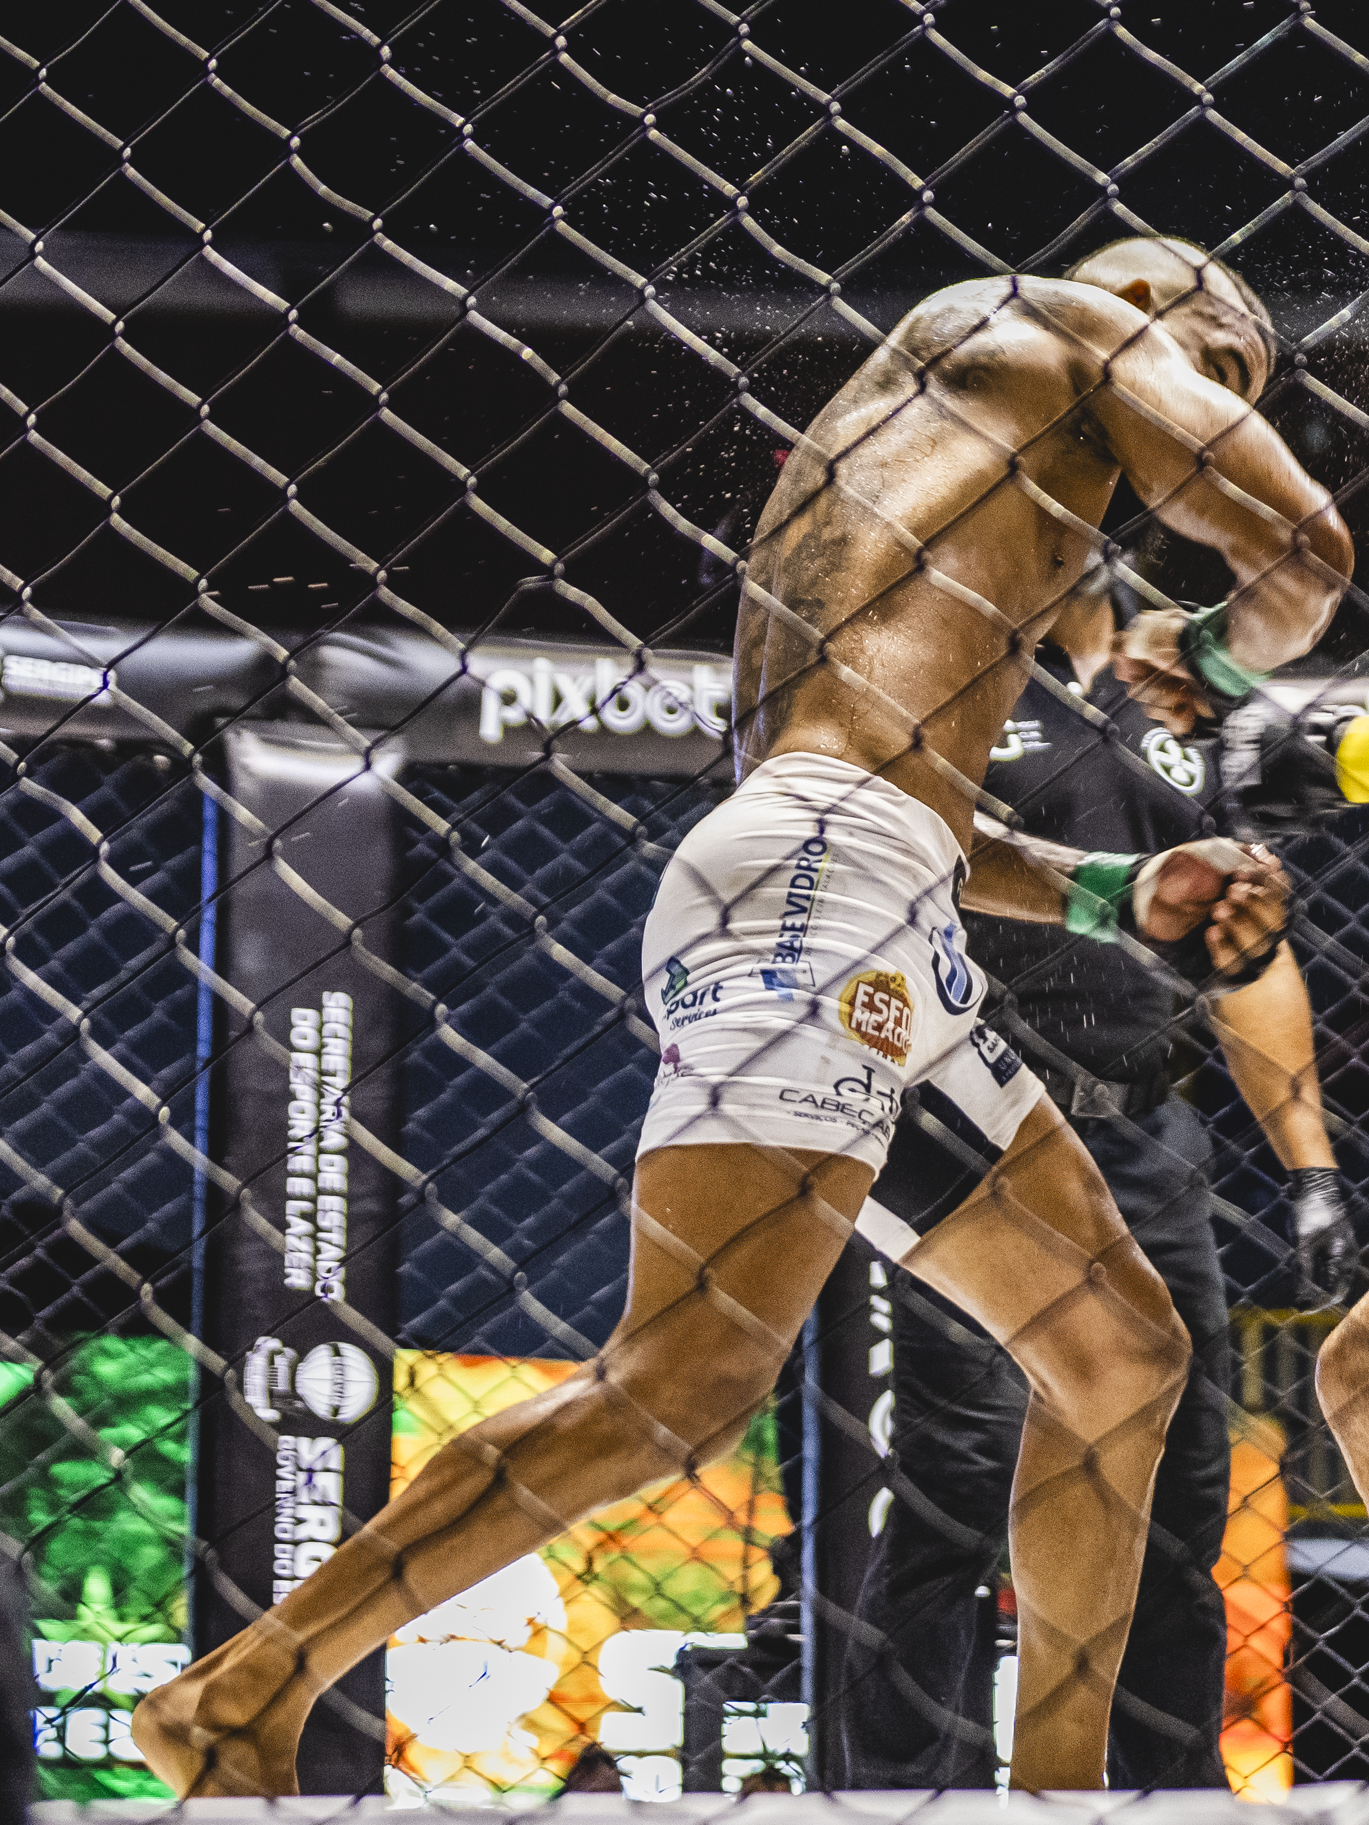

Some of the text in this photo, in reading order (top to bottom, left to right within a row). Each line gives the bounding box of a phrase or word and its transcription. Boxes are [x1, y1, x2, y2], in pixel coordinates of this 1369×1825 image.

[479, 657, 735, 743] pixbet
[284, 1007, 320, 1291] DO ESPORTE E LAZER
[315, 990, 353, 1303] SECRETARIA DE ESTADO
[272, 1543, 295, 1578] DO
[294, 1436, 345, 1590] SERG
